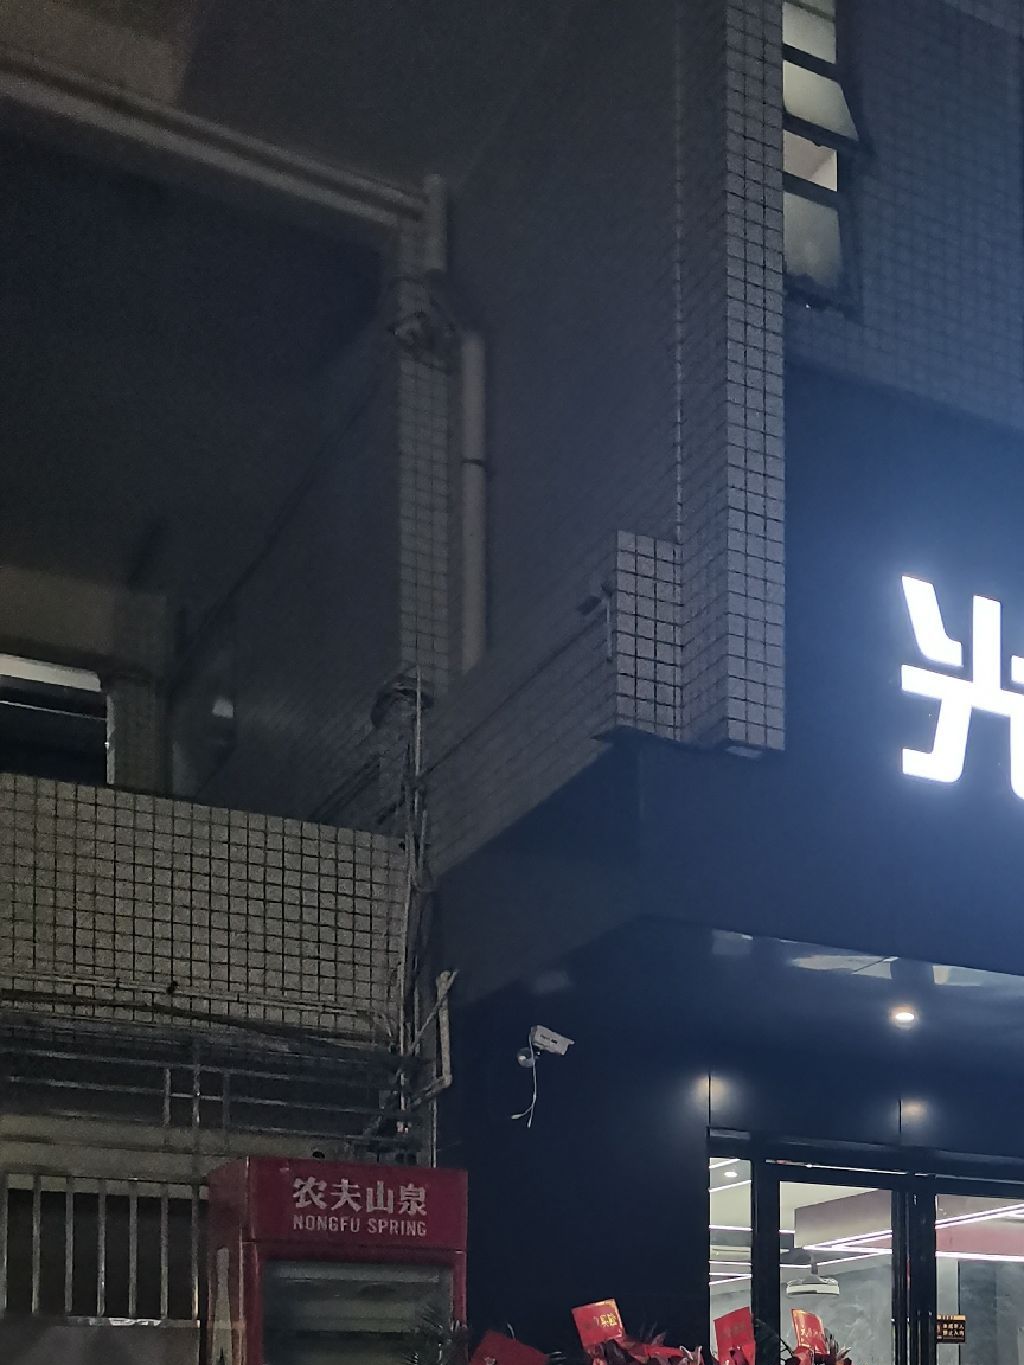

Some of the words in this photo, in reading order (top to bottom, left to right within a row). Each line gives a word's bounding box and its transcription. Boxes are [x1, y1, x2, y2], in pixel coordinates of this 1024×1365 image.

[293, 1177, 428, 1216] 农夫山泉
[293, 1215, 361, 1233] NONGFU
[367, 1218, 428, 1237] SPRING
